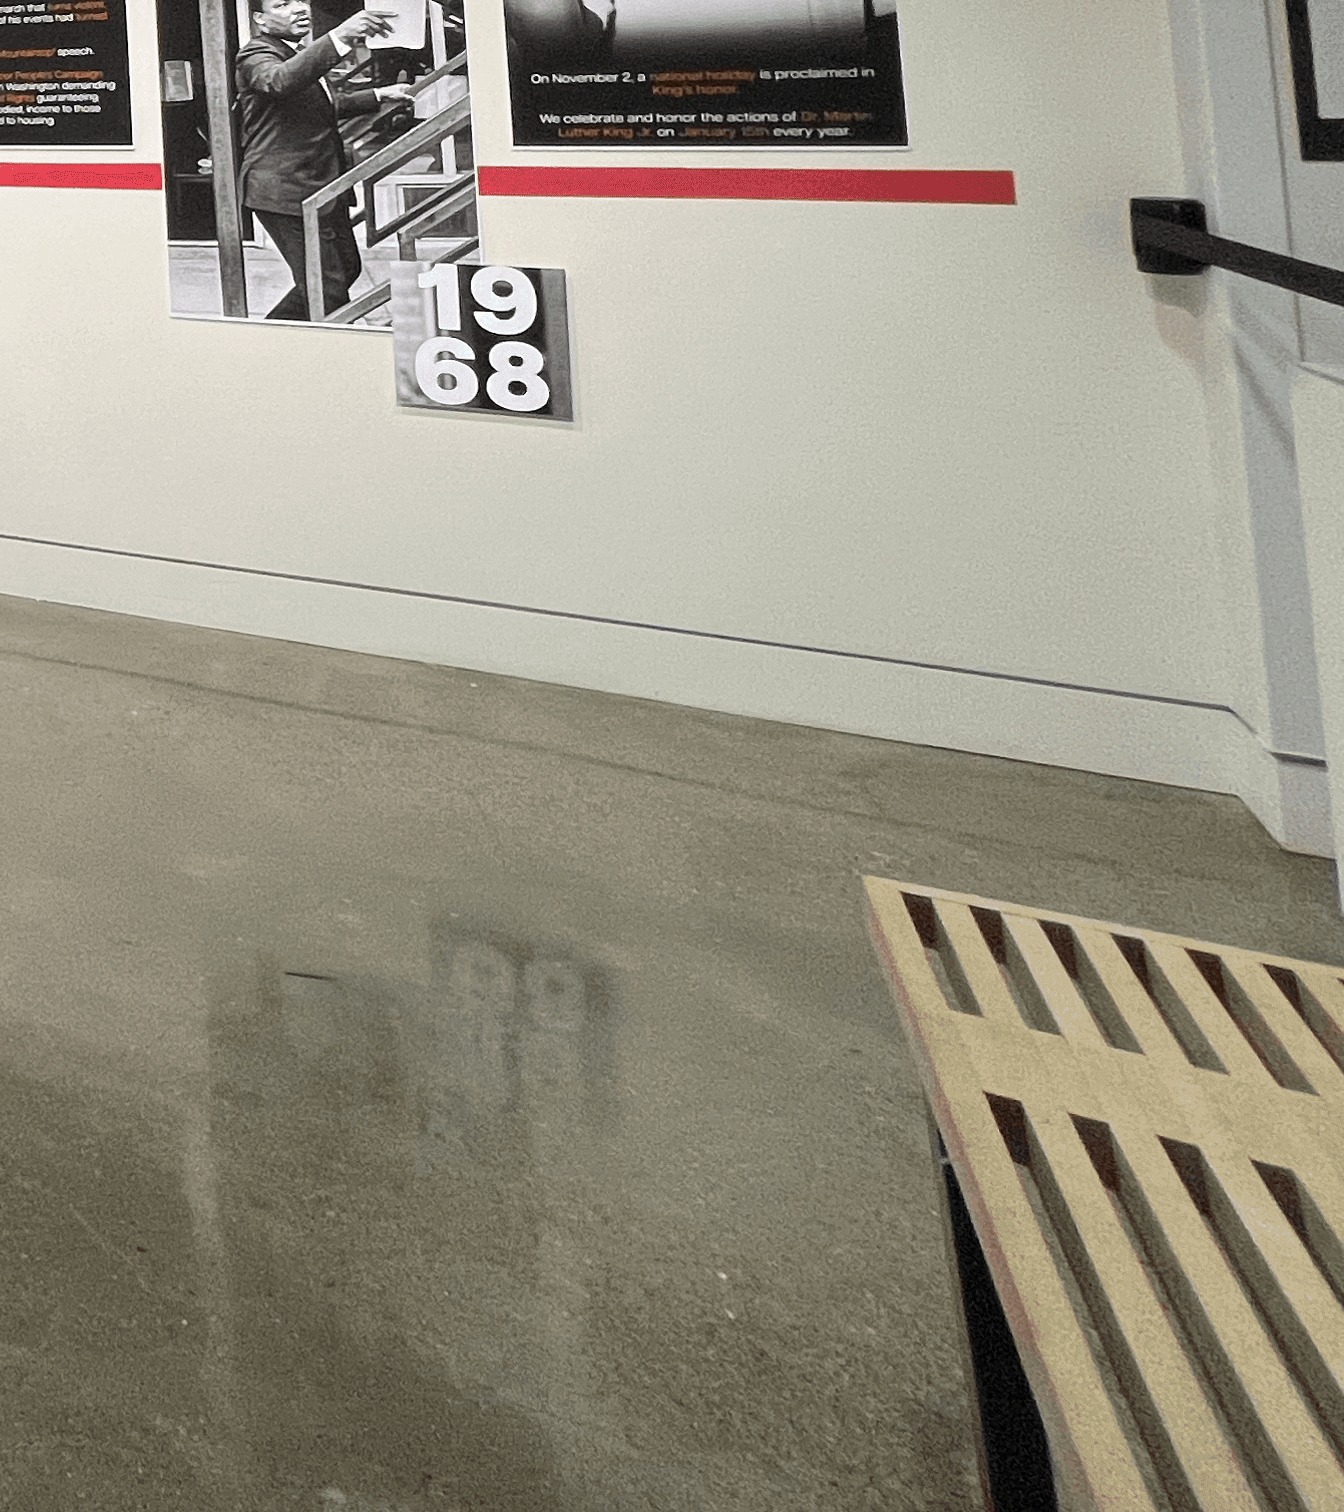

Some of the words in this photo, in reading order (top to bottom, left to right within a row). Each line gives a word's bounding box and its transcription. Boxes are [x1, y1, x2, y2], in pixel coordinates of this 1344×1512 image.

[552, 72, 618, 83] November
[775, 68, 858, 82] proclaimed
[563, 113, 623, 123] celebrate
[627, 113, 653, 122] and
[656, 113, 696, 122] honor
[701, 112, 723, 122] the
[726, 112, 779, 122] actions
[773, 129, 812, 138] every
[419, 263, 537, 335] 19
[415, 336, 549, 412] 68
